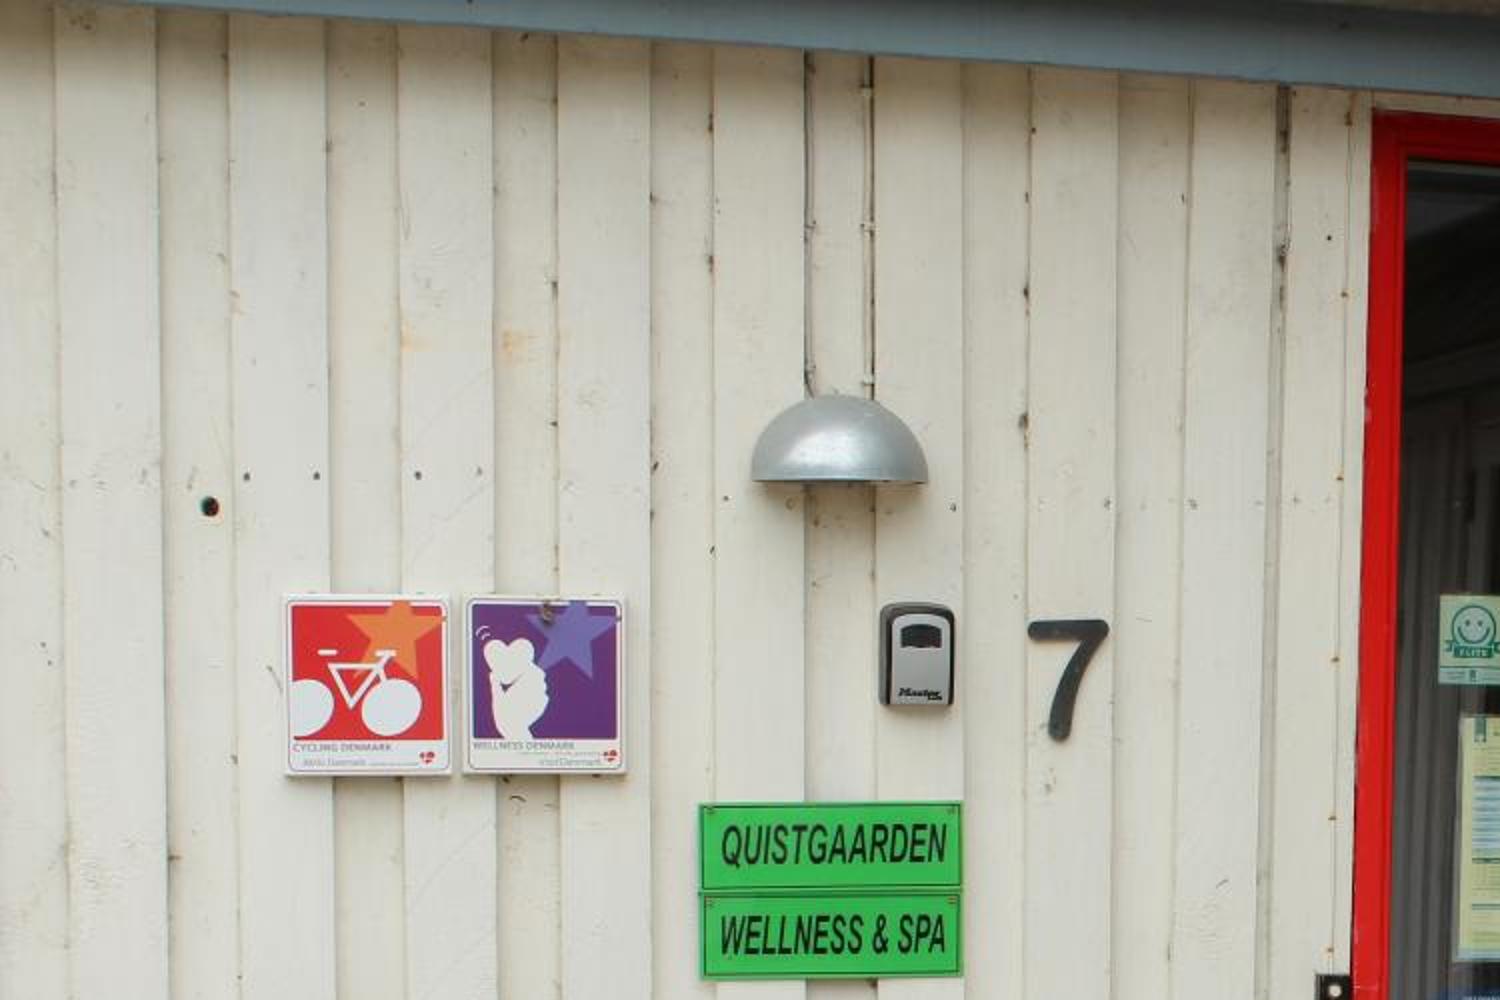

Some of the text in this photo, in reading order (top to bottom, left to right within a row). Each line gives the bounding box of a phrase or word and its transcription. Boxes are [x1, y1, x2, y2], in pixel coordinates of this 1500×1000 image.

[1027, 618, 1110, 742] 7
[292, 743, 391, 752] CYCLING DENMARK
[473, 742, 575, 750] WELLNESS DENMARK
[721, 823, 947, 867] QUISTGAARDEN
[721, 914, 945, 955] WELLNESS & SPA
